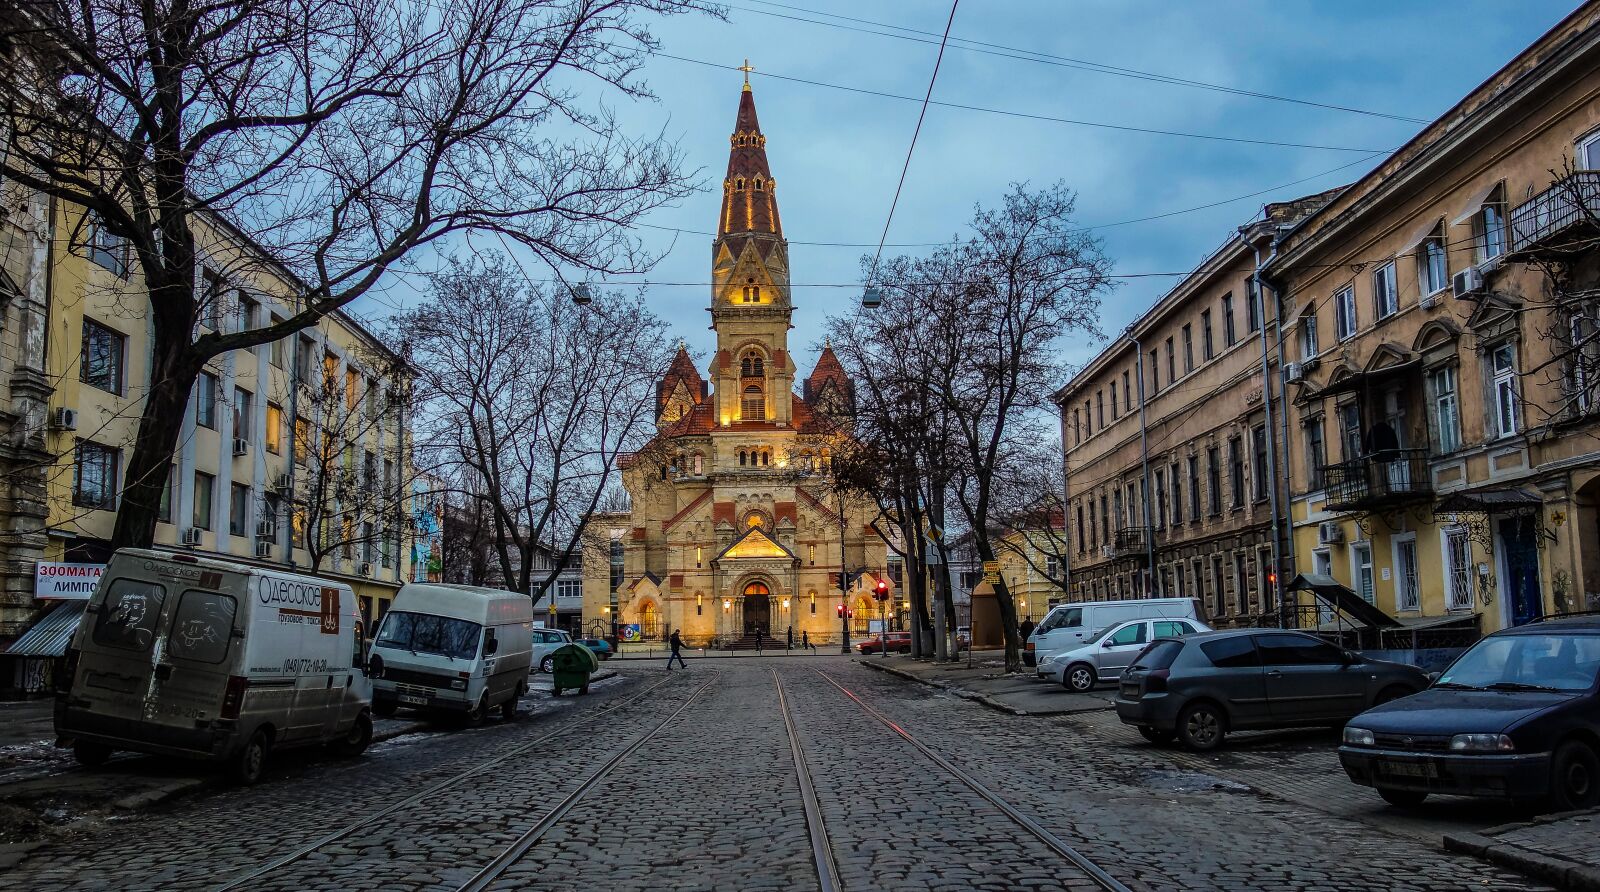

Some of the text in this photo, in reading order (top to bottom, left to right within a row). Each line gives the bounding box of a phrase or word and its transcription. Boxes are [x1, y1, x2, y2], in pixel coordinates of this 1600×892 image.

[40, 565, 104, 577] ЗООМАГА
[143, 561, 200, 577] Одесское
[258, 575, 321, 607] Одесское
